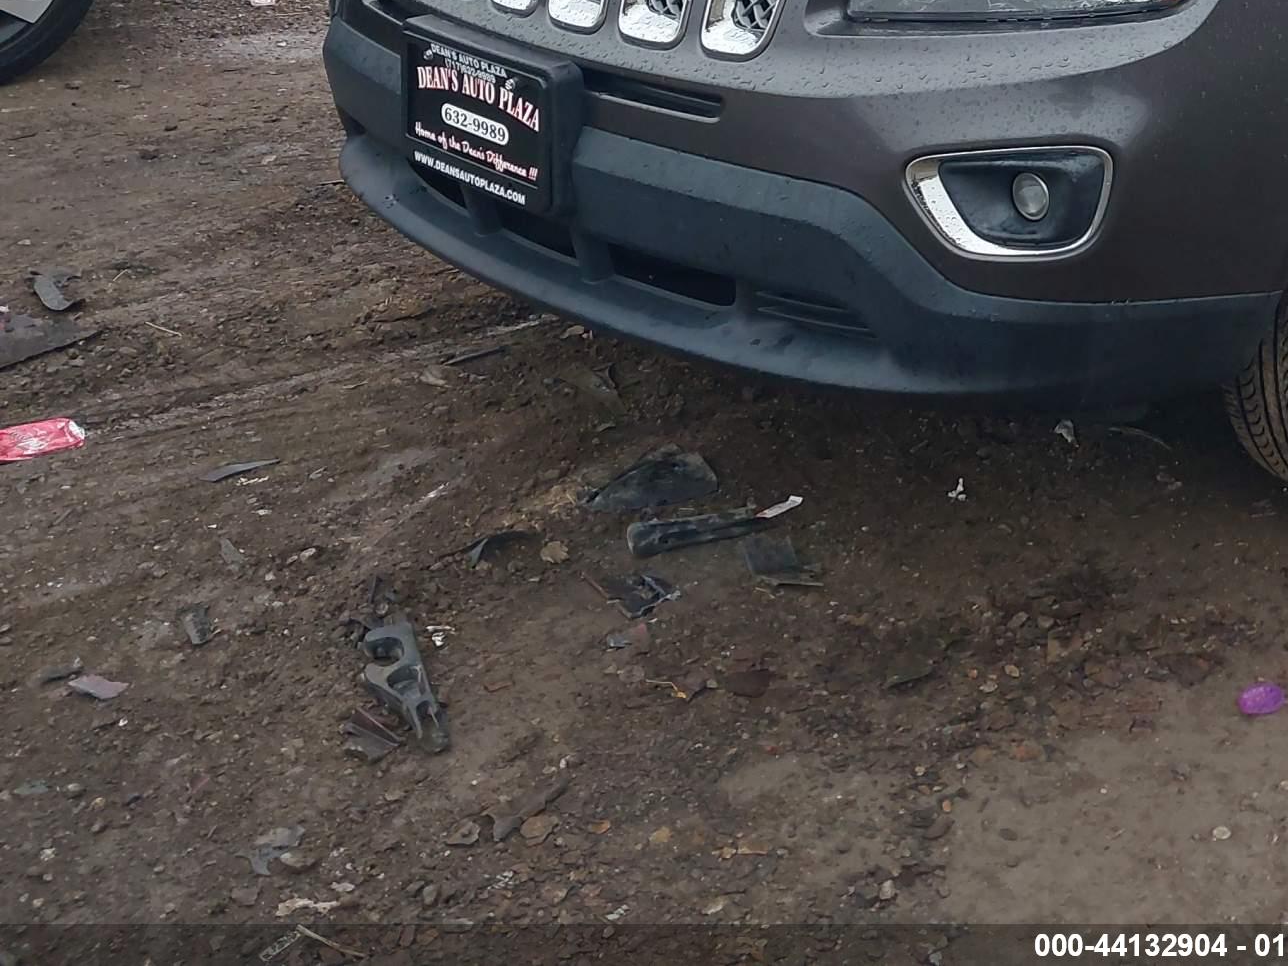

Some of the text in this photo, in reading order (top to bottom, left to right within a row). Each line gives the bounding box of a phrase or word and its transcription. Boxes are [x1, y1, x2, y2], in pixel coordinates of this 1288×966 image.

[430, 43, 508, 78] DEAN'S AUTO PLAZA
[417, 66, 540, 132] DEAN'S AUTO PLAZA
[415, 121, 436, 141] Home
[437, 131, 448, 150] of
[448, 135, 461, 151] the
[444, 107, 506, 142] 632-9989
[414, 150, 526, 205] WWW.DEANSAUTOPLAZA.COM
